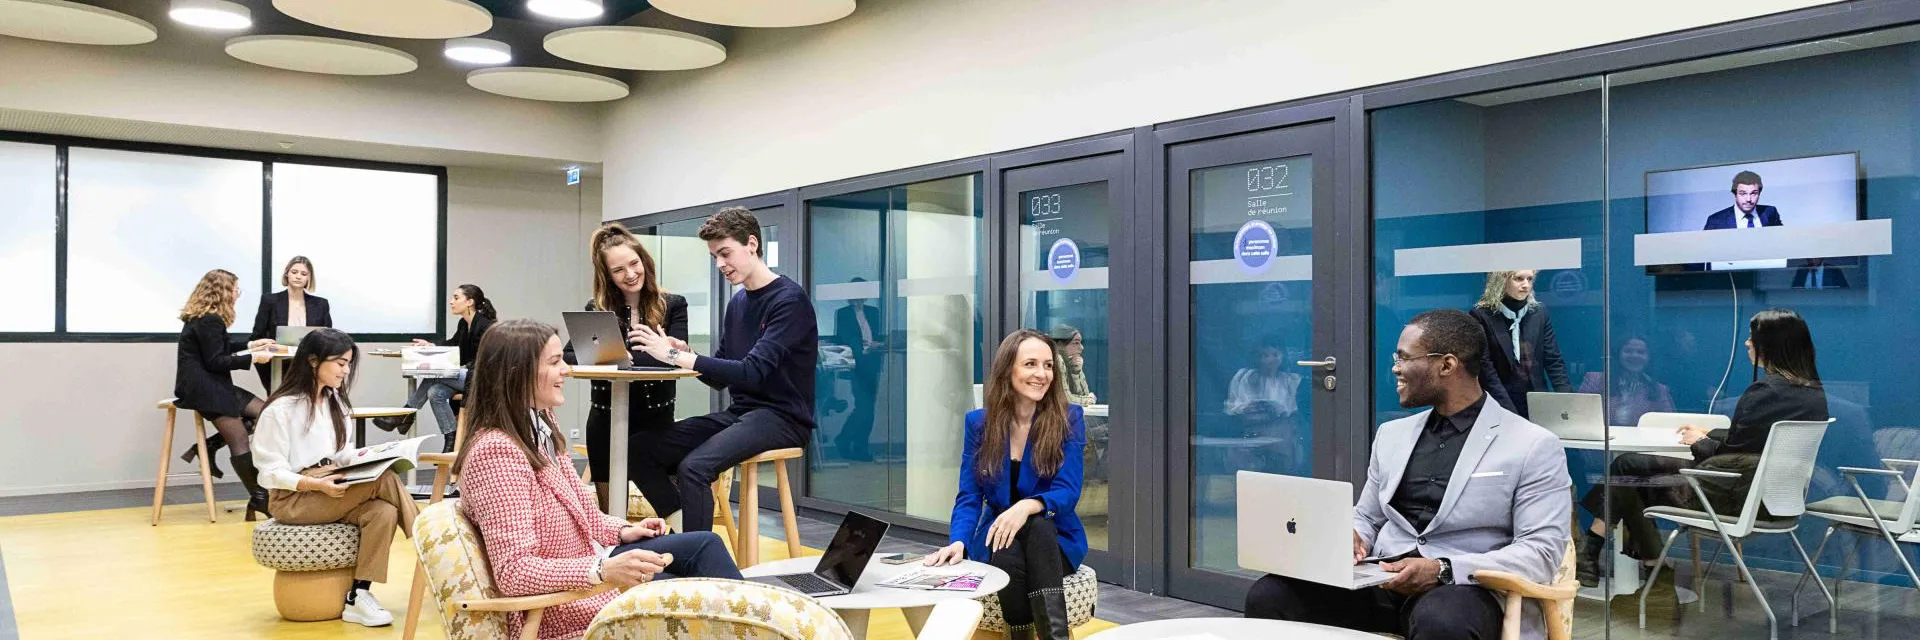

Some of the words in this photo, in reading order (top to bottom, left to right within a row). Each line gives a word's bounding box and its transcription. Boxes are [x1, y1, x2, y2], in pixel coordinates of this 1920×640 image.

[1247, 164, 1288, 192] 032
[1031, 193, 1060, 216] 033
[1247, 199, 1267, 208] Salle
[1247, 208, 1257, 216] de
[1257, 206, 1288, 215] réunion
